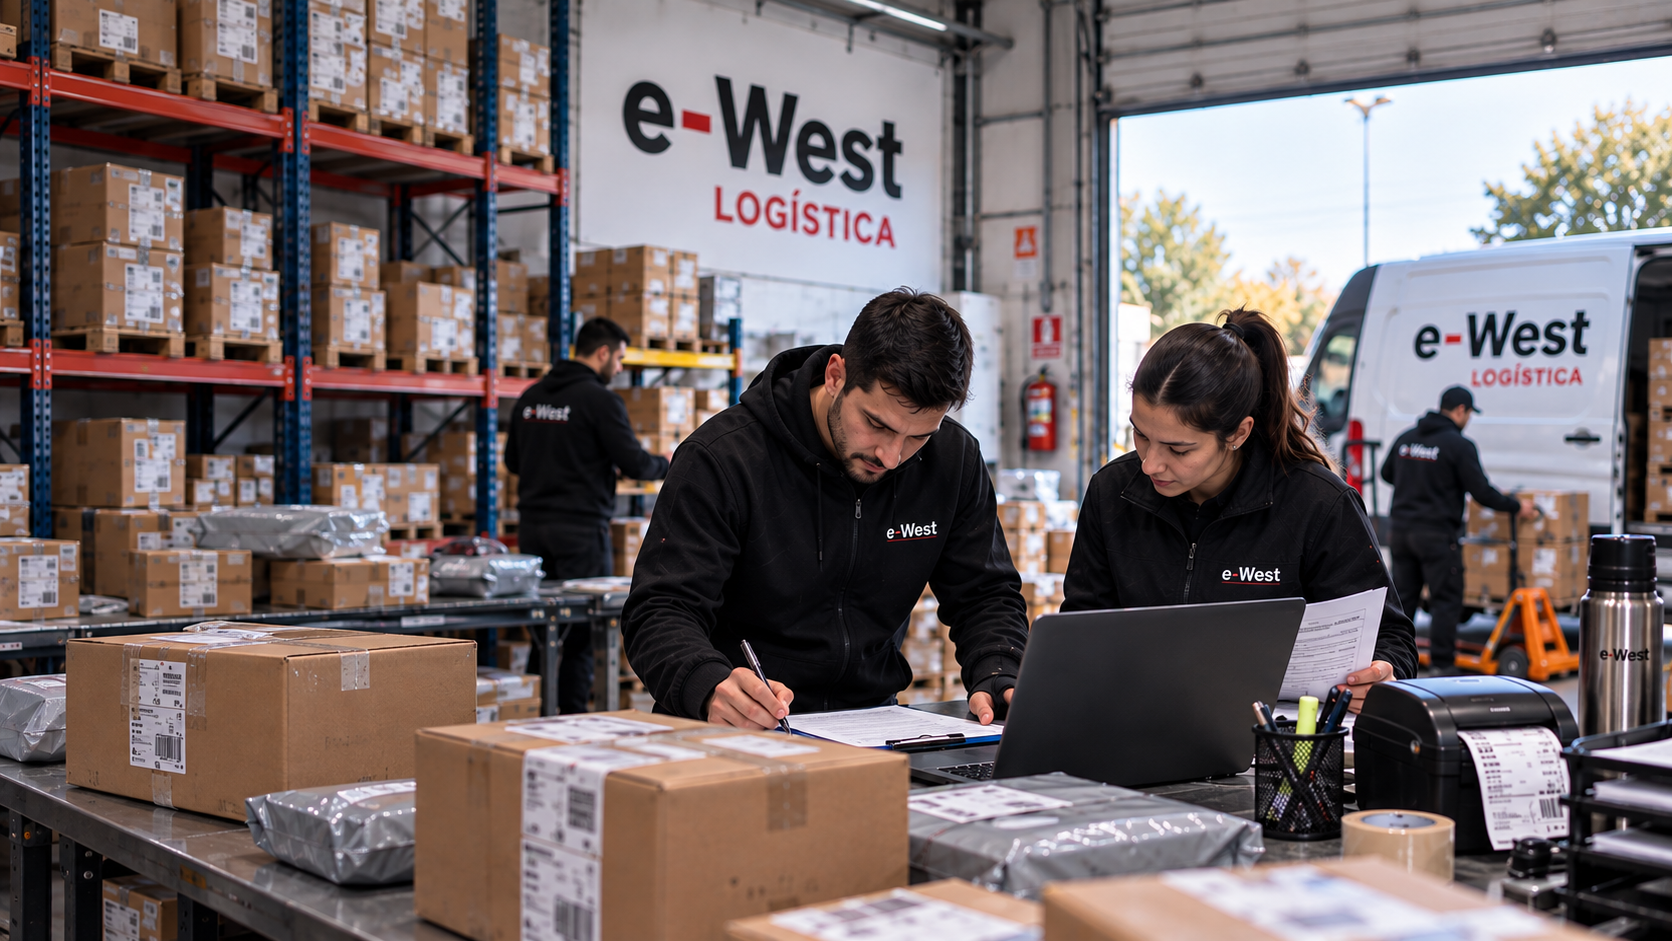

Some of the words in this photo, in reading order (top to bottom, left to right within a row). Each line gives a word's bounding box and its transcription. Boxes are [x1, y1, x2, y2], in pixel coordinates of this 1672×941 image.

[622, 74, 904, 199] e-West
[714, 185, 897, 249] LOGÍSTICA
[1414, 310, 1591, 360] e-West
[1471, 363, 1584, 387] LOGÍSTICA
[522, 403, 571, 422] e-West
[886, 521, 938, 540] e-West
[1221, 566, 1281, 582] e-West
[1600, 648, 1650, 662] e-West
